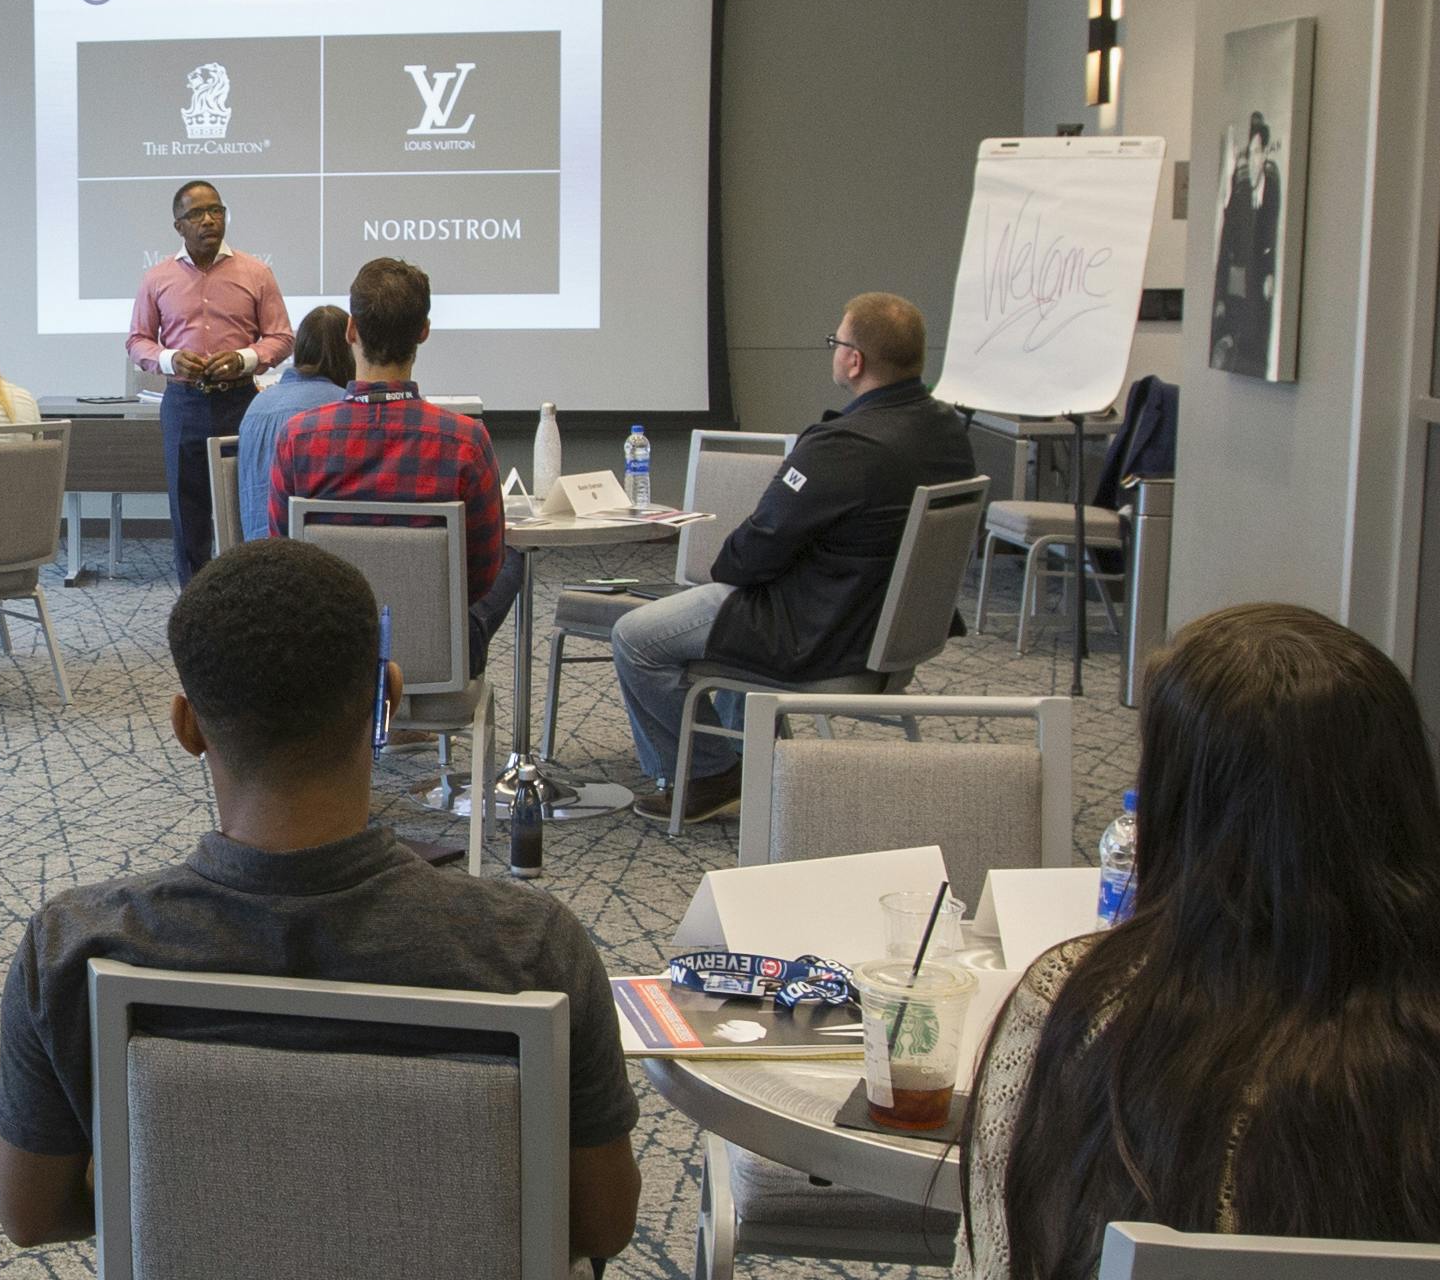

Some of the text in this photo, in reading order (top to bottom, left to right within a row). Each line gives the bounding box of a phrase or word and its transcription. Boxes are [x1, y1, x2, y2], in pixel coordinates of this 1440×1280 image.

[142, 141, 168, 156] THE
[404, 140, 476, 151] LOUIS VUITTON
[363, 218, 522, 241] NORDSTROM
